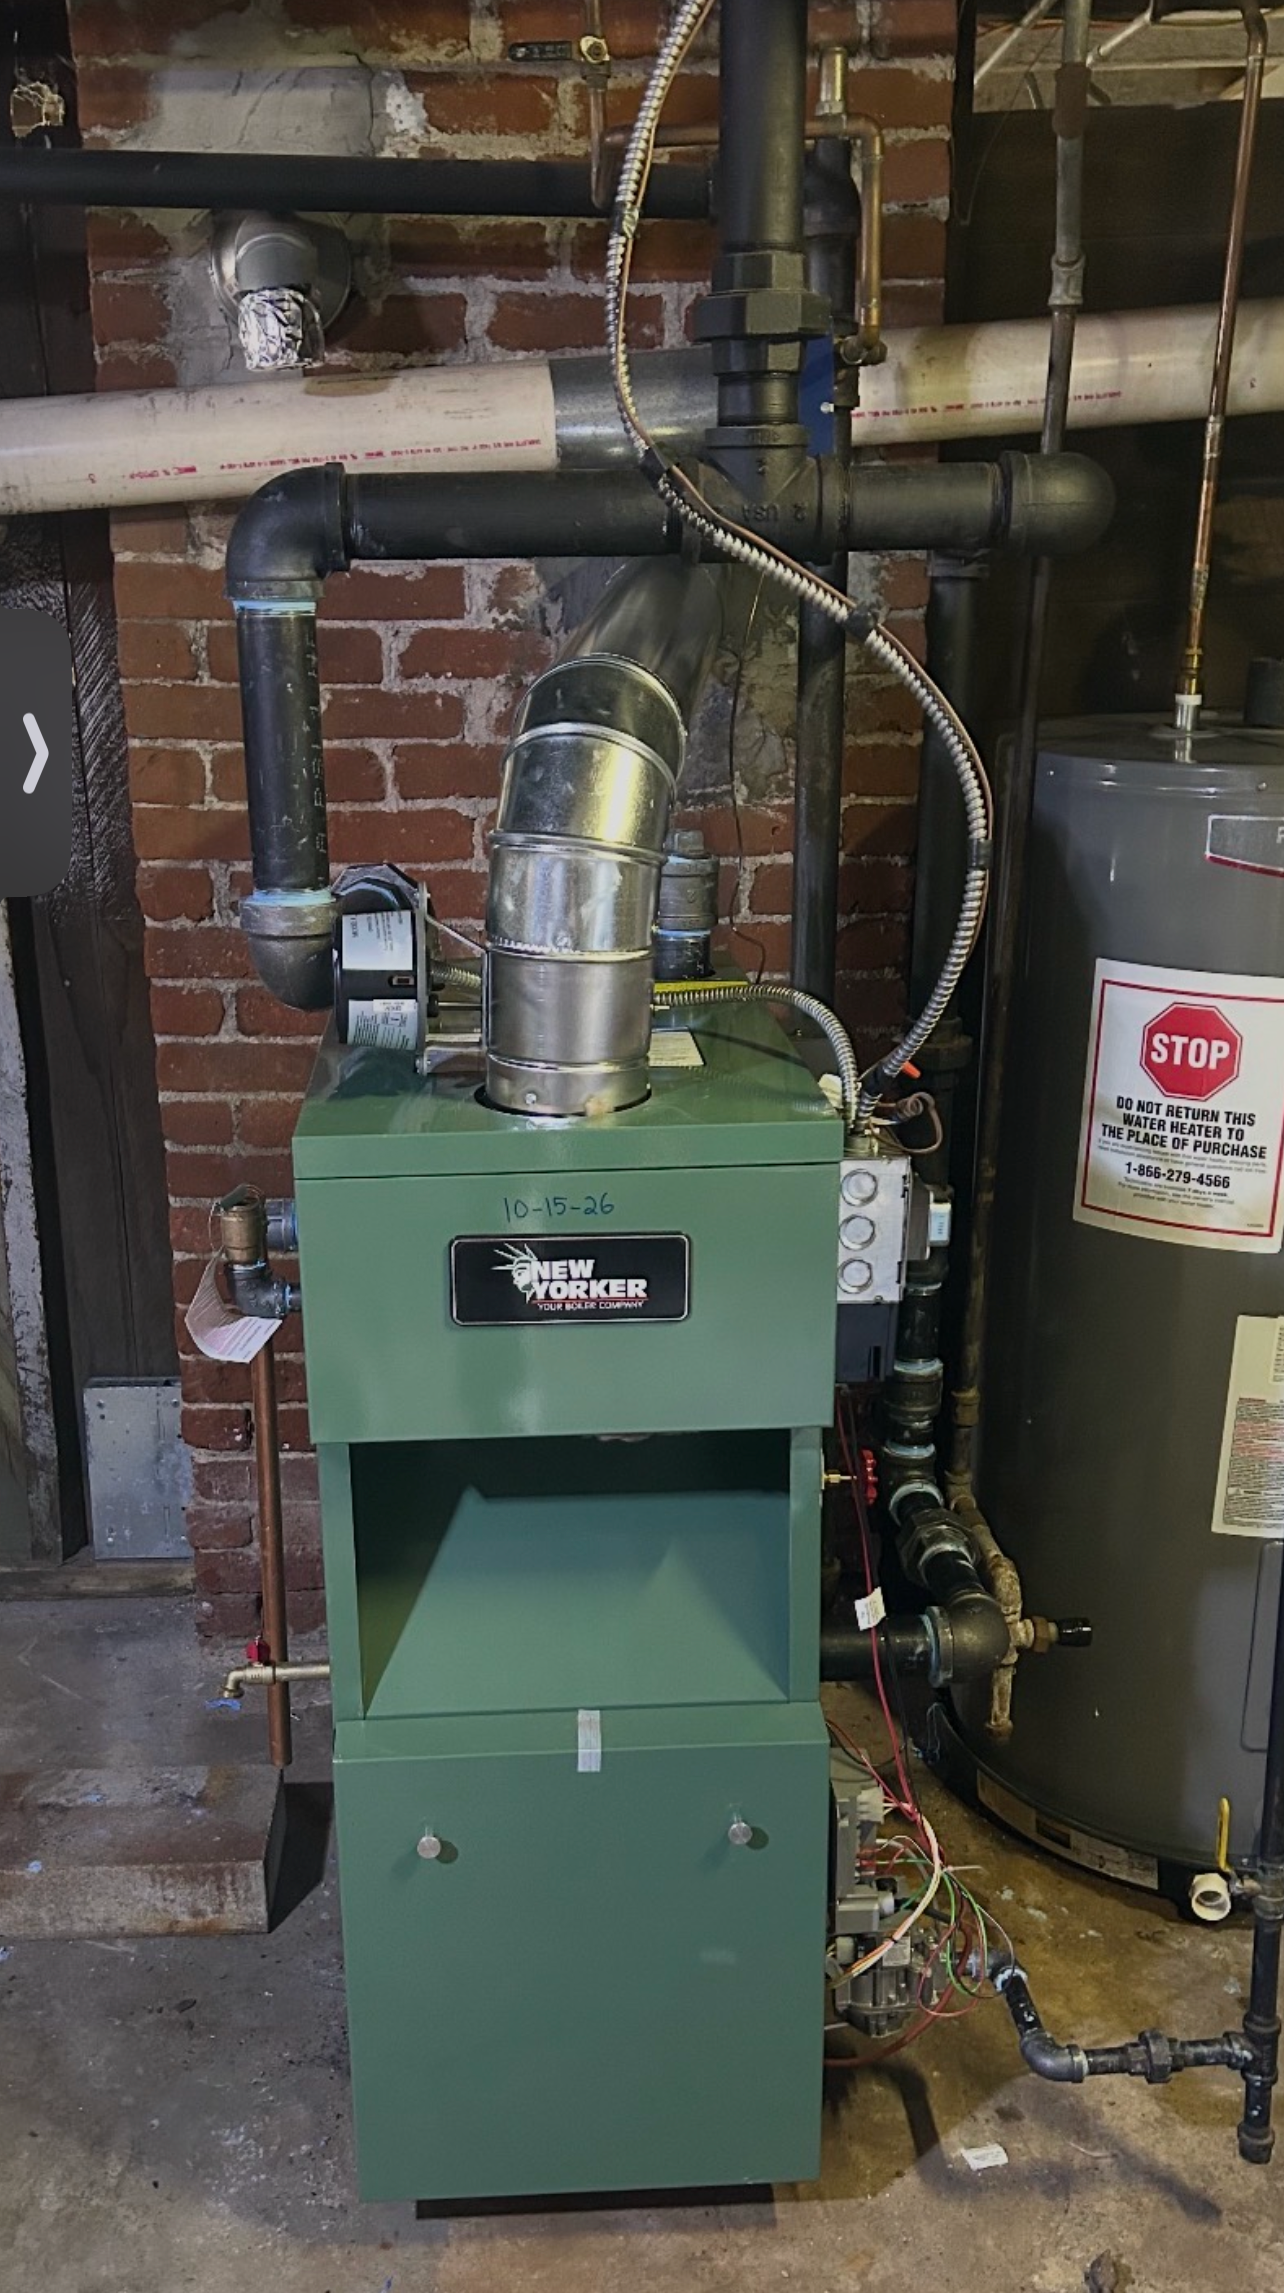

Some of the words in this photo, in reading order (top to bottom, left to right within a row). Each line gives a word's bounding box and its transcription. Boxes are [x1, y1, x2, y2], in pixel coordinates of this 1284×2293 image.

[1150, 1032, 1231, 1070] STOP
[1116, 1095, 1134, 1111] DO
[1136, 1098, 1164, 1115] NOT
[1165, 1103, 1220, 1123] RETURN
[1224, 1111, 1257, 1127] THIS
[1101, 1123, 1124, 1140] THE
[1126, 1129, 1168, 1148] PLACE
[1171, 1136, 1190, 1151] OF
[1193, 1139, 1268, 1160] PURCHASE
[1122, 1112, 1167, 1132] WATER
[1170, 1119, 1222, 1139] HEATER
[1227, 1127, 1245, 1142] TO
[1124, 1161, 1231, 1189] 1-866-279-4566
[503, 1192, 616, 1223] 10-15-26
[531, 1258, 596, 1280] NEW
[533, 1278, 648, 1299] YORKER
[537, 1301, 563, 1312] YOUR
[565, 1301, 597, 1311] BOILER
[598, 1300, 645, 1311] COMPANY
